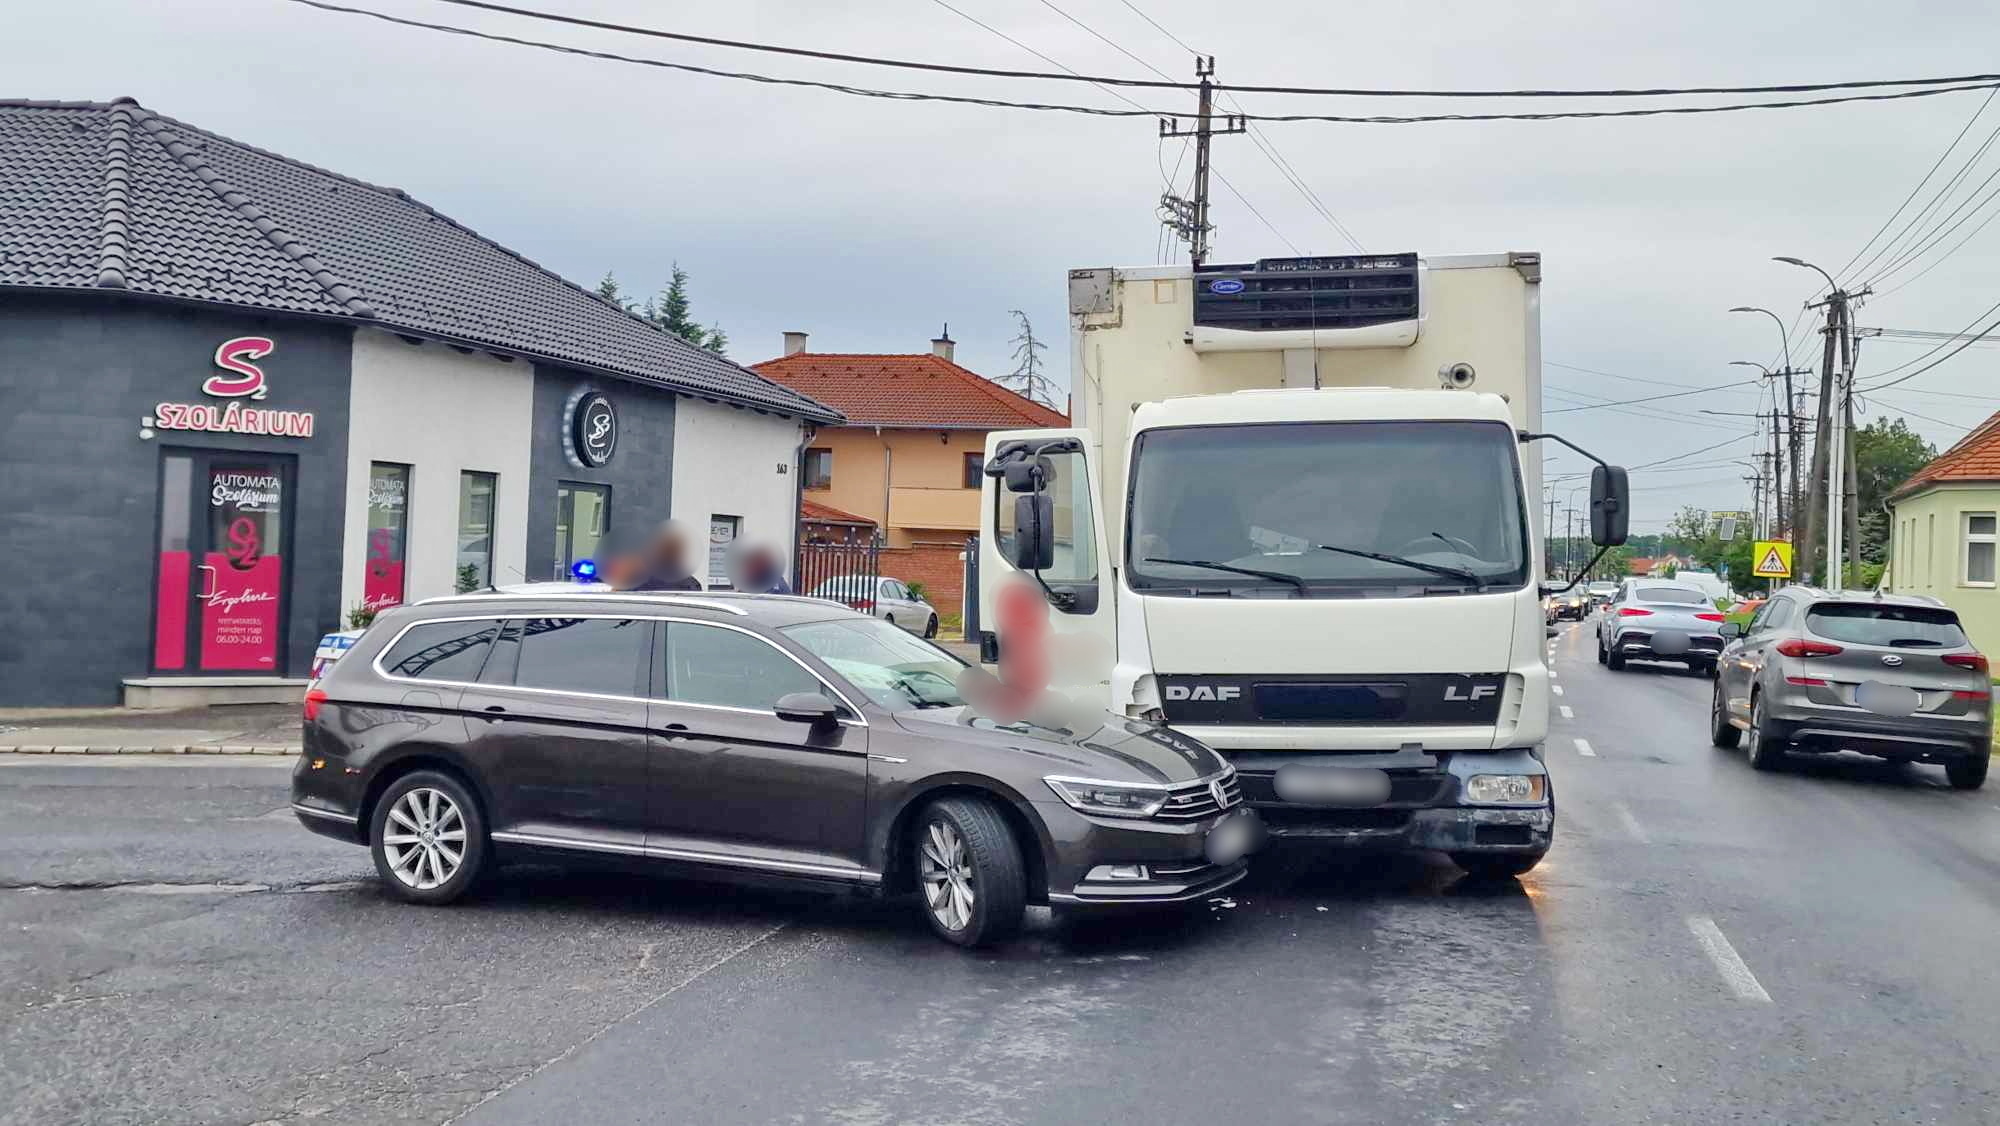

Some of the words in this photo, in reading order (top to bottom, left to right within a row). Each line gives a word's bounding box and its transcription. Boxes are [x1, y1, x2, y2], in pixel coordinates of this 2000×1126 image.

[155, 401, 313, 437] SZOLÁRIUM
[213, 474, 280, 489] AUTOMATA
[211, 485, 280, 507] Szolárium
[207, 588, 277, 614] Ergoline
[1165, 685, 1241, 701] DAF
[1443, 685, 1498, 701] LF
